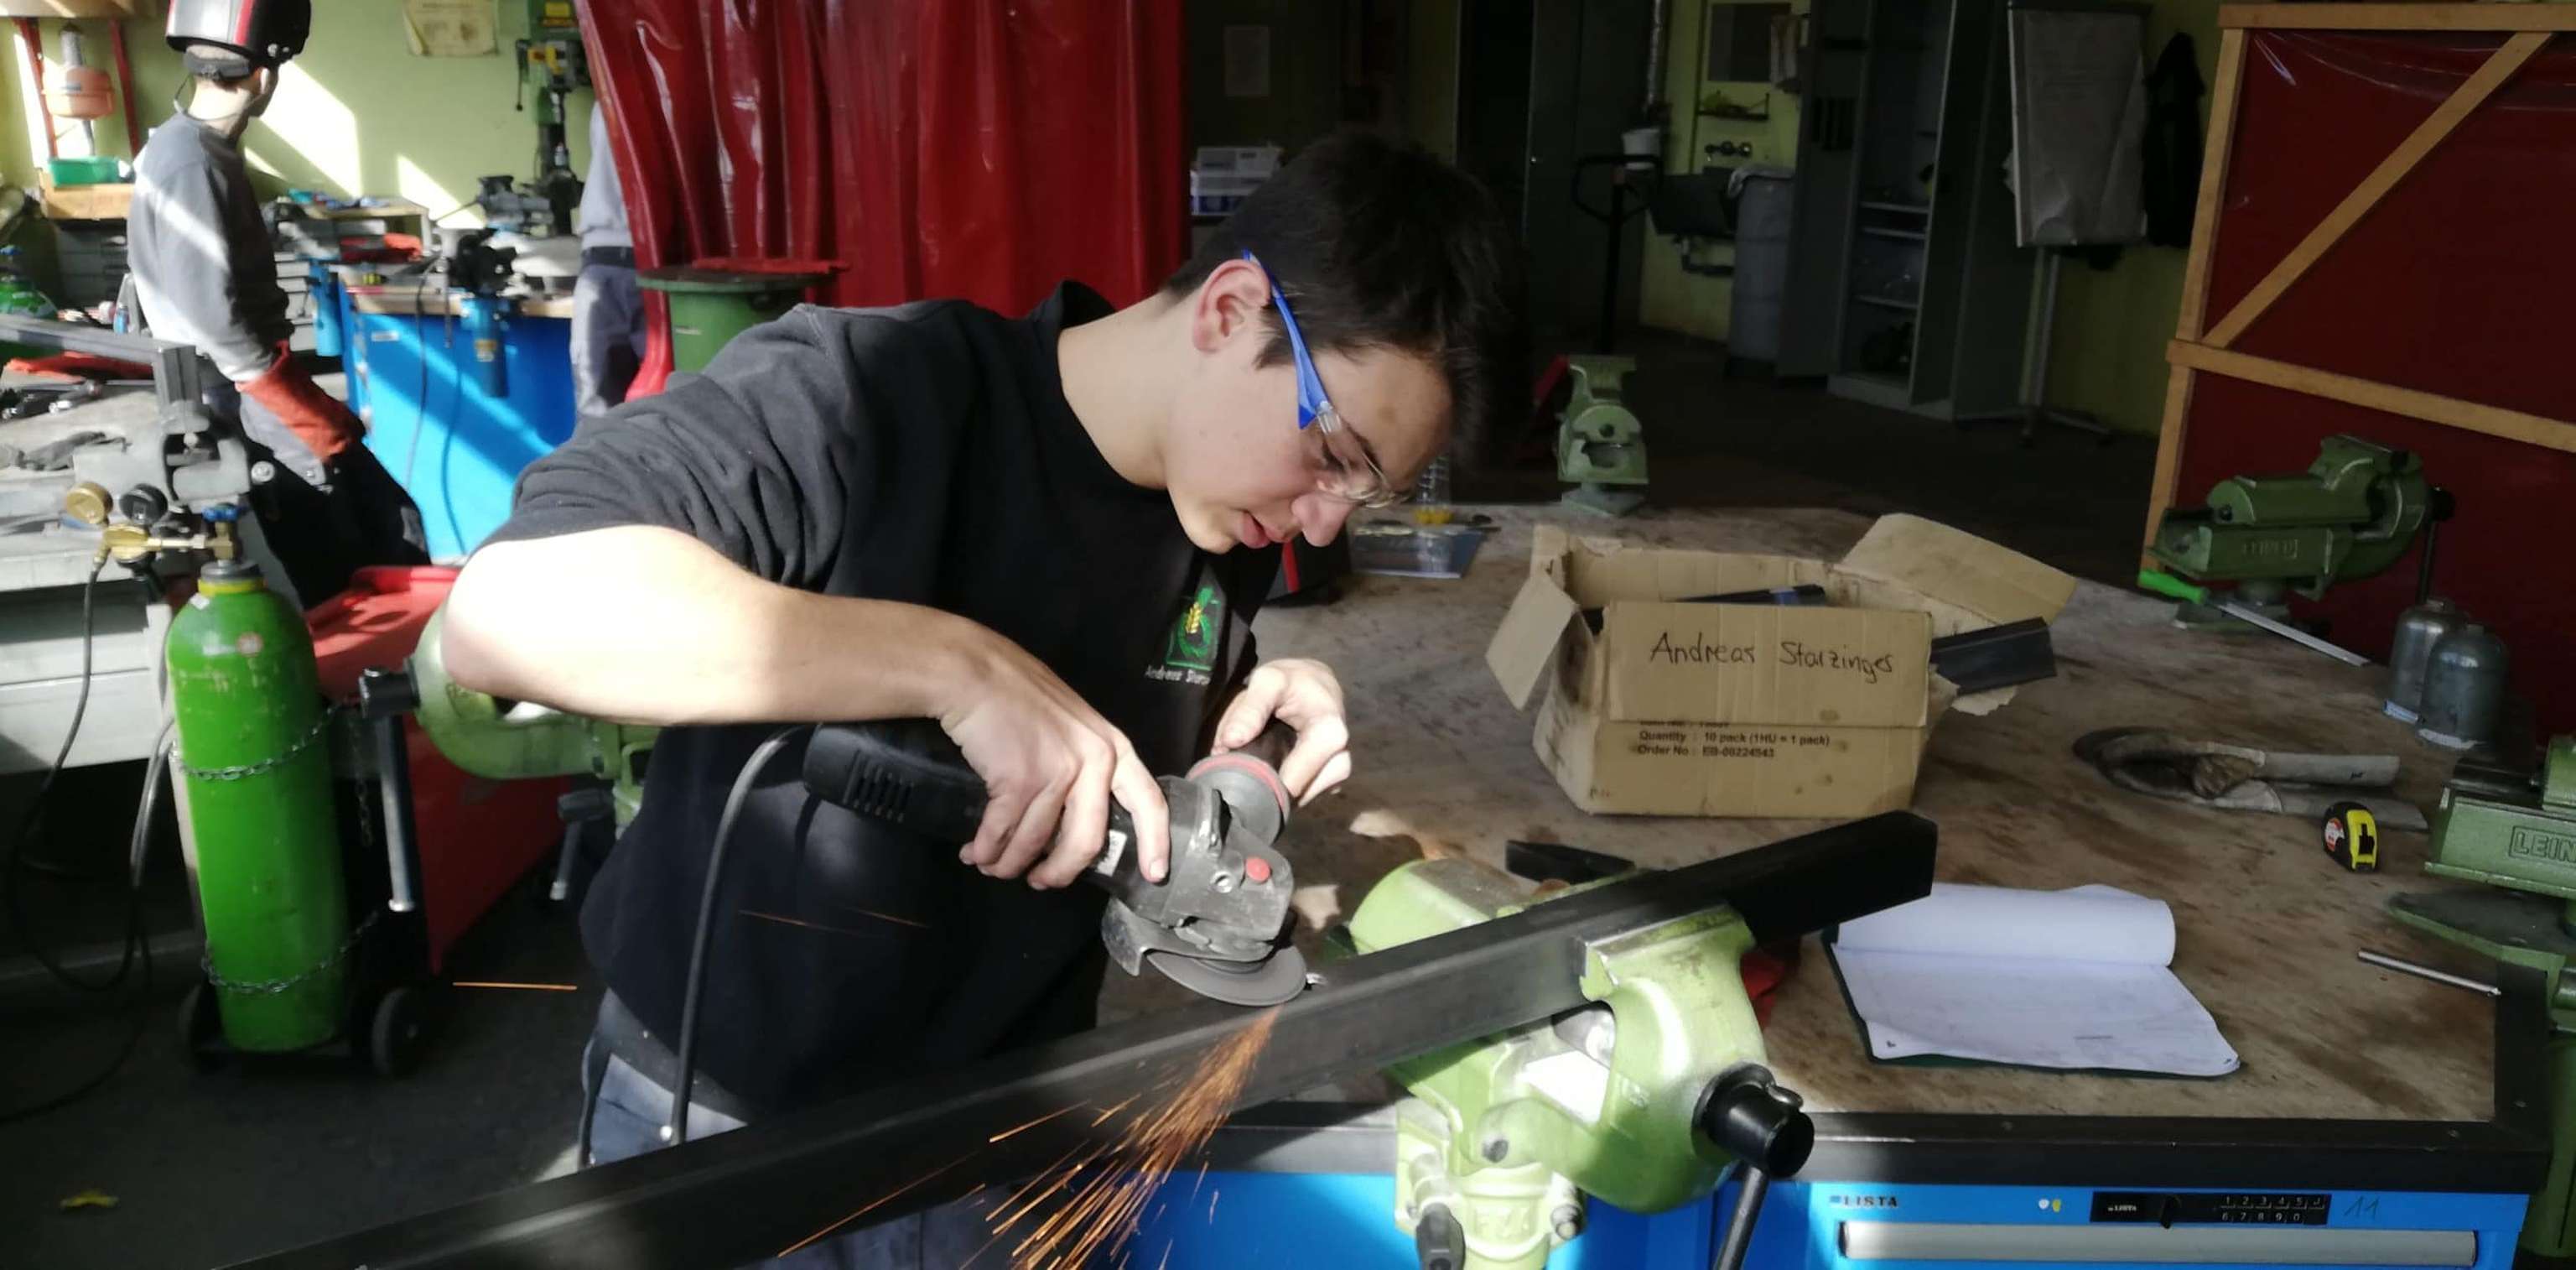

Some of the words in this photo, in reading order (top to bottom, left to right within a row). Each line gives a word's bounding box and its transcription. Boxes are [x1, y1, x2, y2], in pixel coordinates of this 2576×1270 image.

[1650, 632, 1755, 664] Andreas
[1639, 731, 1686, 743] Quantity
[1705, 731, 1716, 742] 10
[1719, 732, 1745, 744] pack
[1800, 735, 1831, 747] pack)
[1637, 744, 1670, 755] Order
[1844, 1195, 1898, 1208] LISTA
